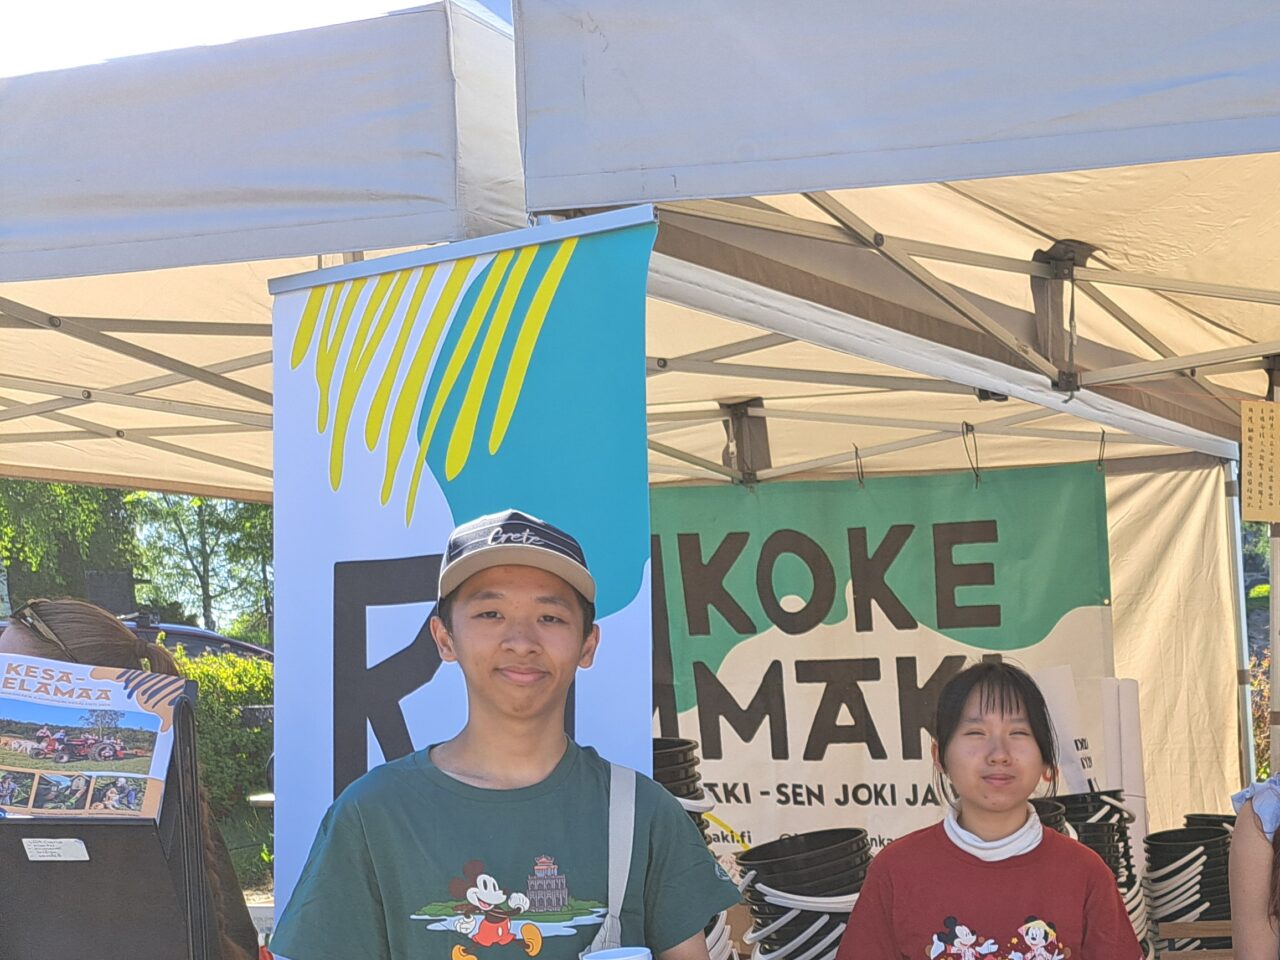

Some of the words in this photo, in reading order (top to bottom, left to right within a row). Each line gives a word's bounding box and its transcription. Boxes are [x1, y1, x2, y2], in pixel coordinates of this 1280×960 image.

[677, 519, 1001, 638] KOKE
[776, 783, 824, 806] SEN
[834, 783, 898, 806] JOKI
[905, 783, 940, 806] JA
